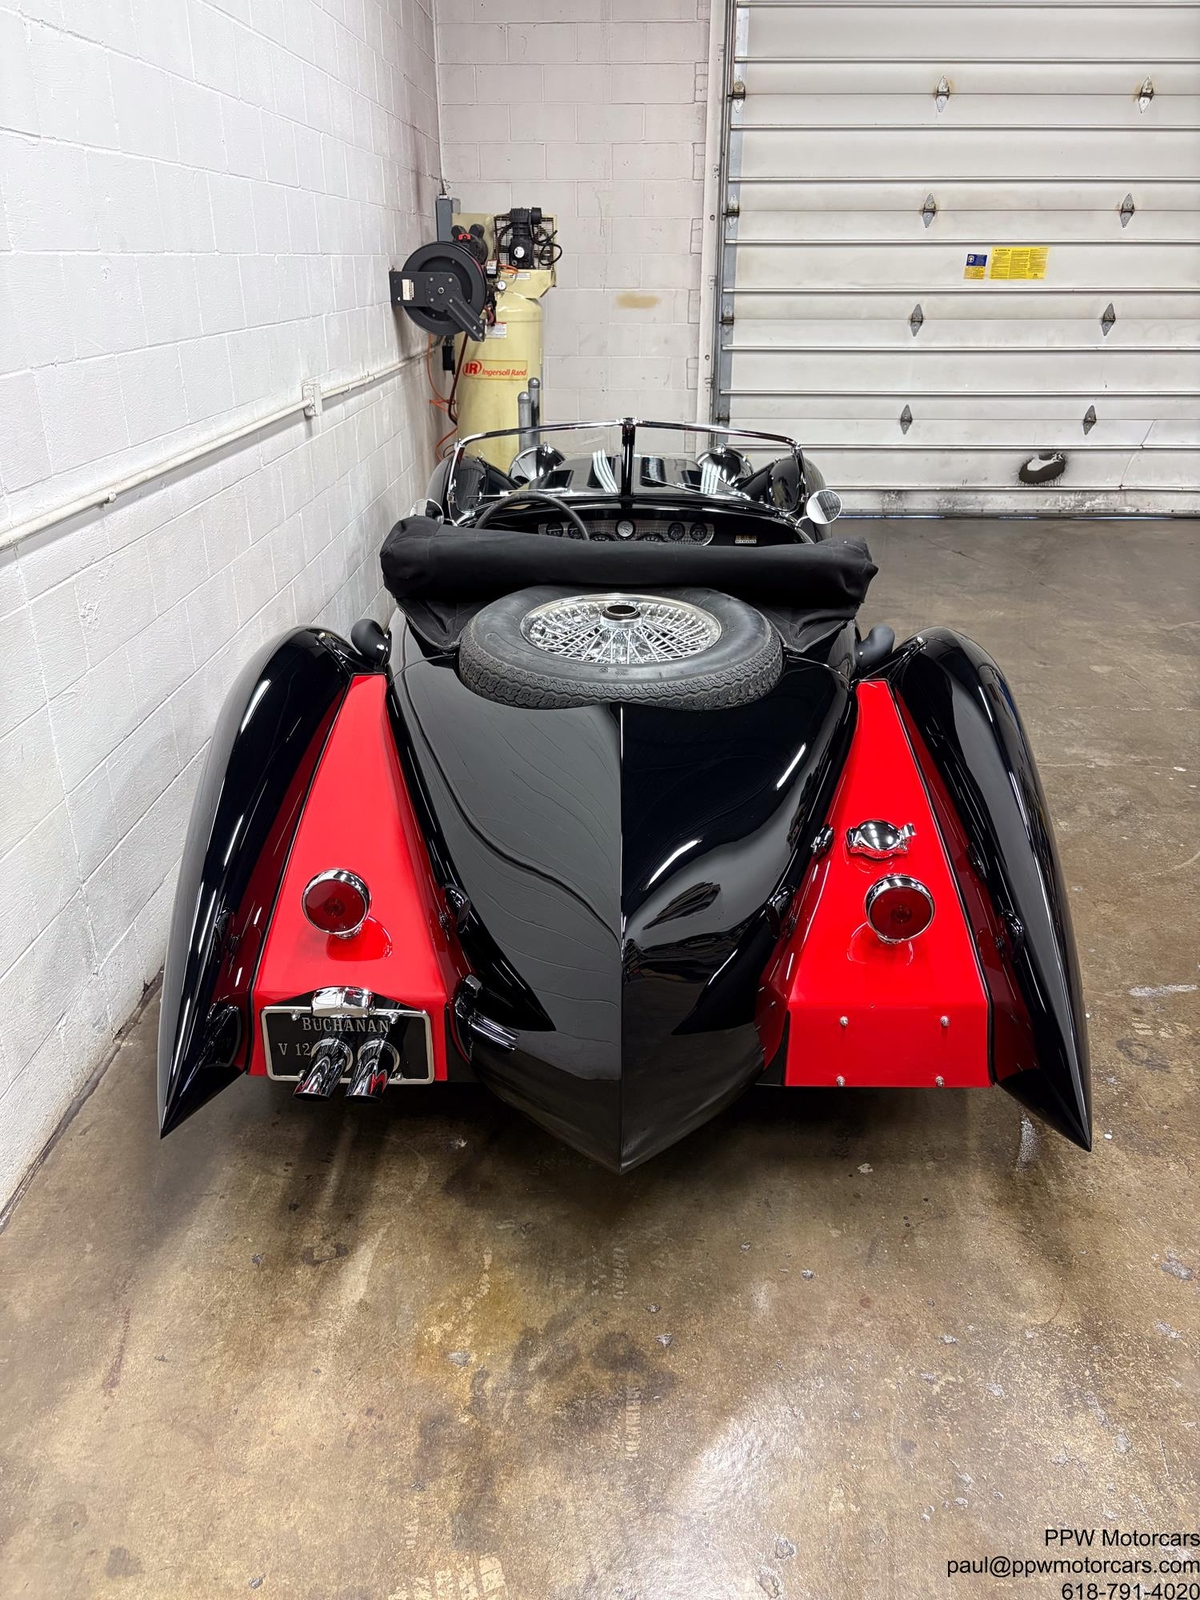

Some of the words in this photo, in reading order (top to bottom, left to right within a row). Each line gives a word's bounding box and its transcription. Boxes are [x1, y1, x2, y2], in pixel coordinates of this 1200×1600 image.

[464, 361, 480, 376] IR
[302, 1017, 390, 1032] BUCHANAN
[278, 1043, 288, 1056] V
